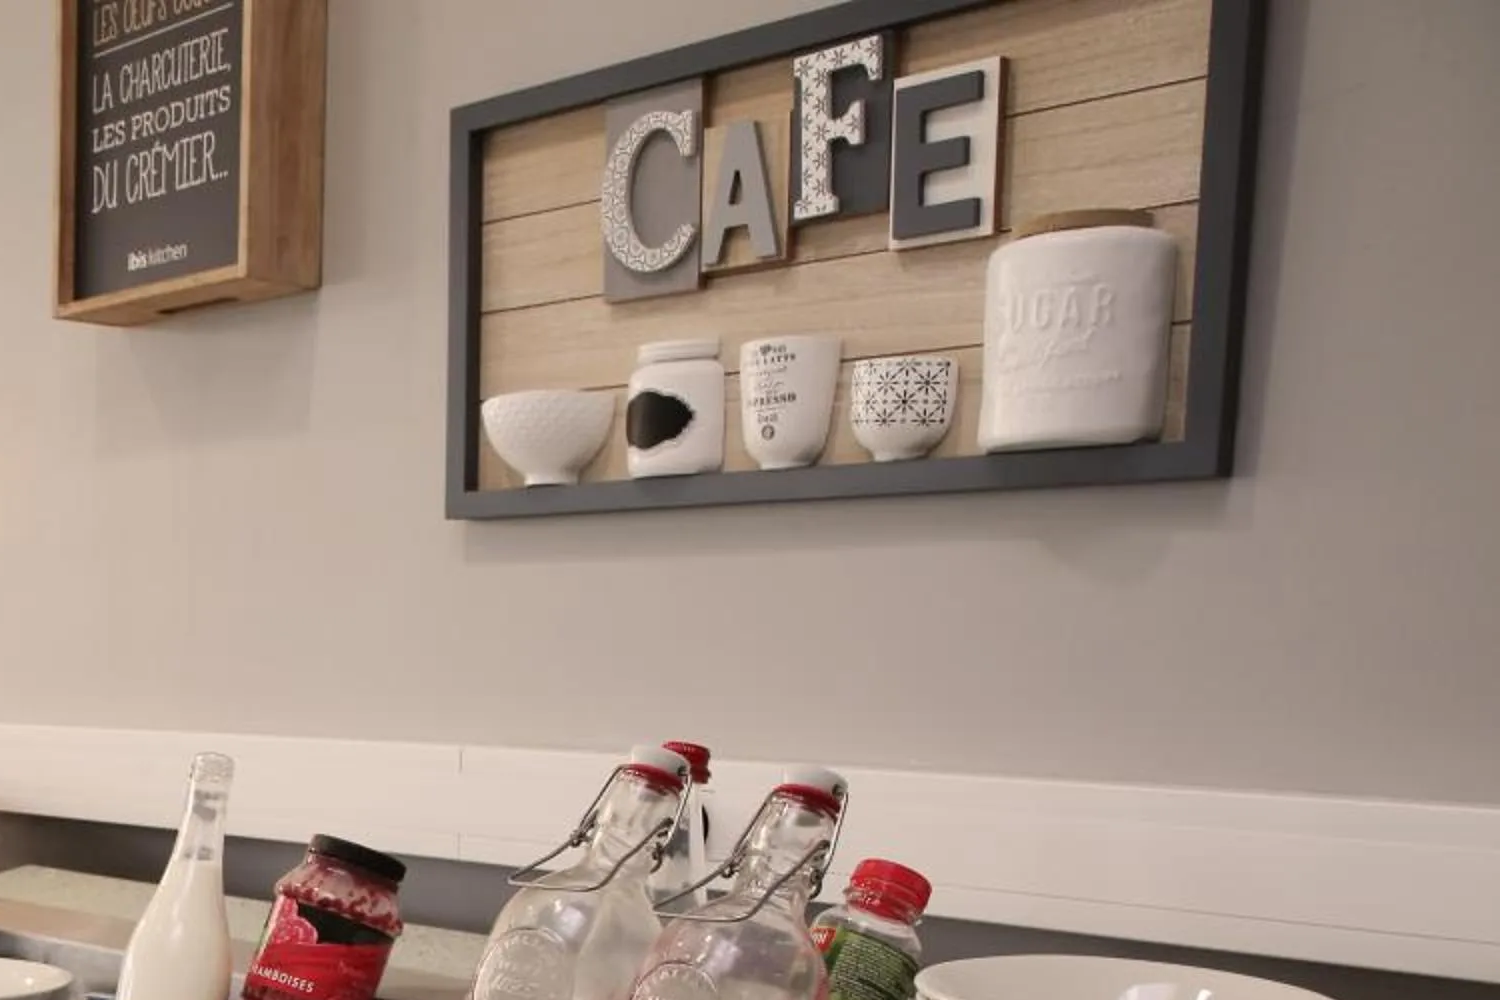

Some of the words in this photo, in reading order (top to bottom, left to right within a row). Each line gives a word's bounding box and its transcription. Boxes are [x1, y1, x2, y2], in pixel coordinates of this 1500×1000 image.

[93, 72, 114, 115] LA
[93, 120, 126, 153] LES
[131, 85, 232, 140] PRODUITS
[601, 33, 985, 274] CAFE
[91, 159, 119, 214] DU
[251, 962, 315, 993] RAMBOISES
